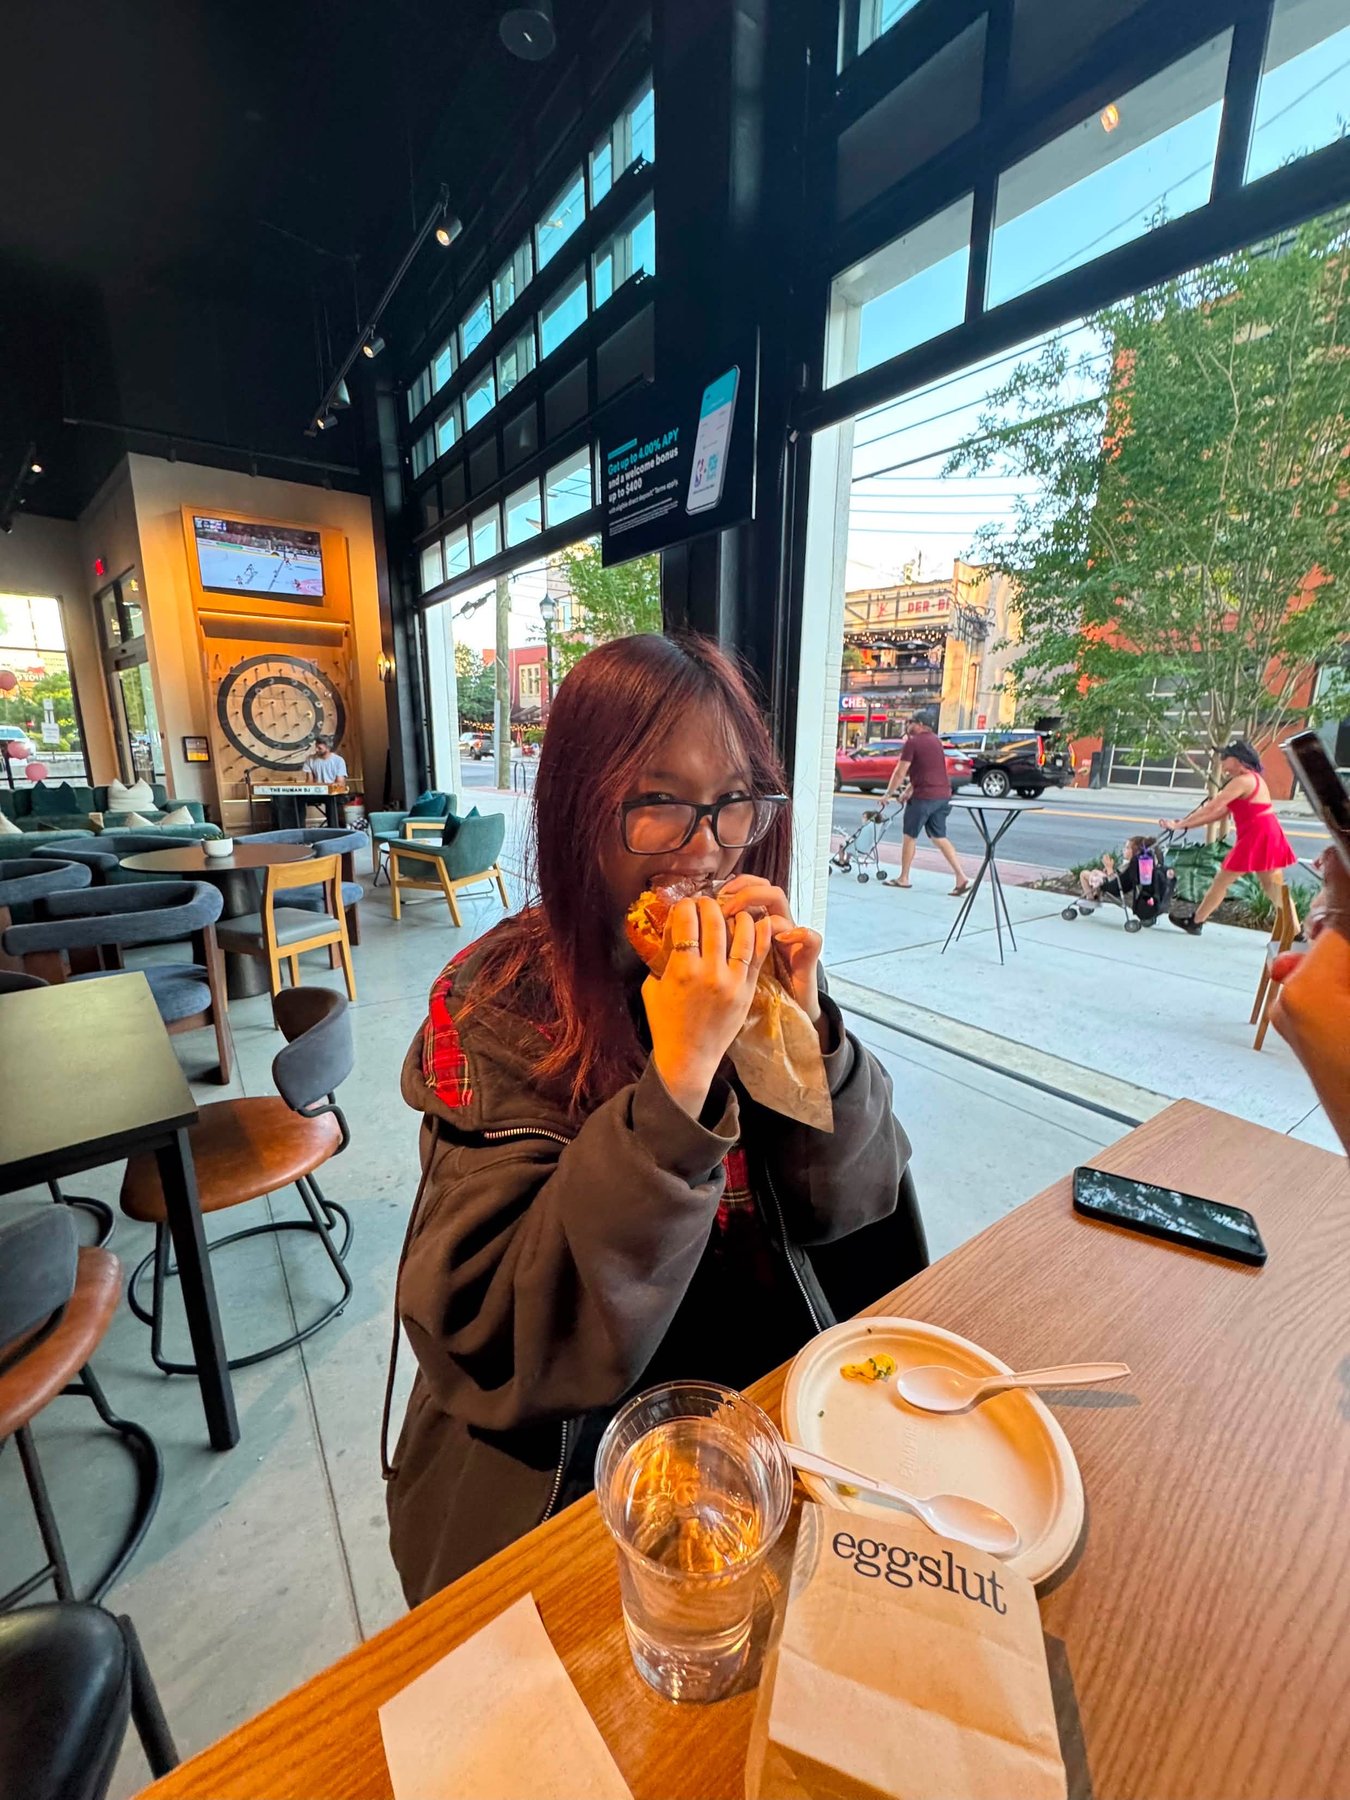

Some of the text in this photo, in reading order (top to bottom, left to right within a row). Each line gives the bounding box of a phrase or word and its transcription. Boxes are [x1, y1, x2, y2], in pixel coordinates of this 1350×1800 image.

[608, 427, 679, 475] Get up to 4.00% APY
[608, 447, 679, 490] and a welcome bonus
[608, 477, 642, 504] up to $400
[907, 600, 930, 614] DER
[832, 1532, 1007, 1615] eggslut
